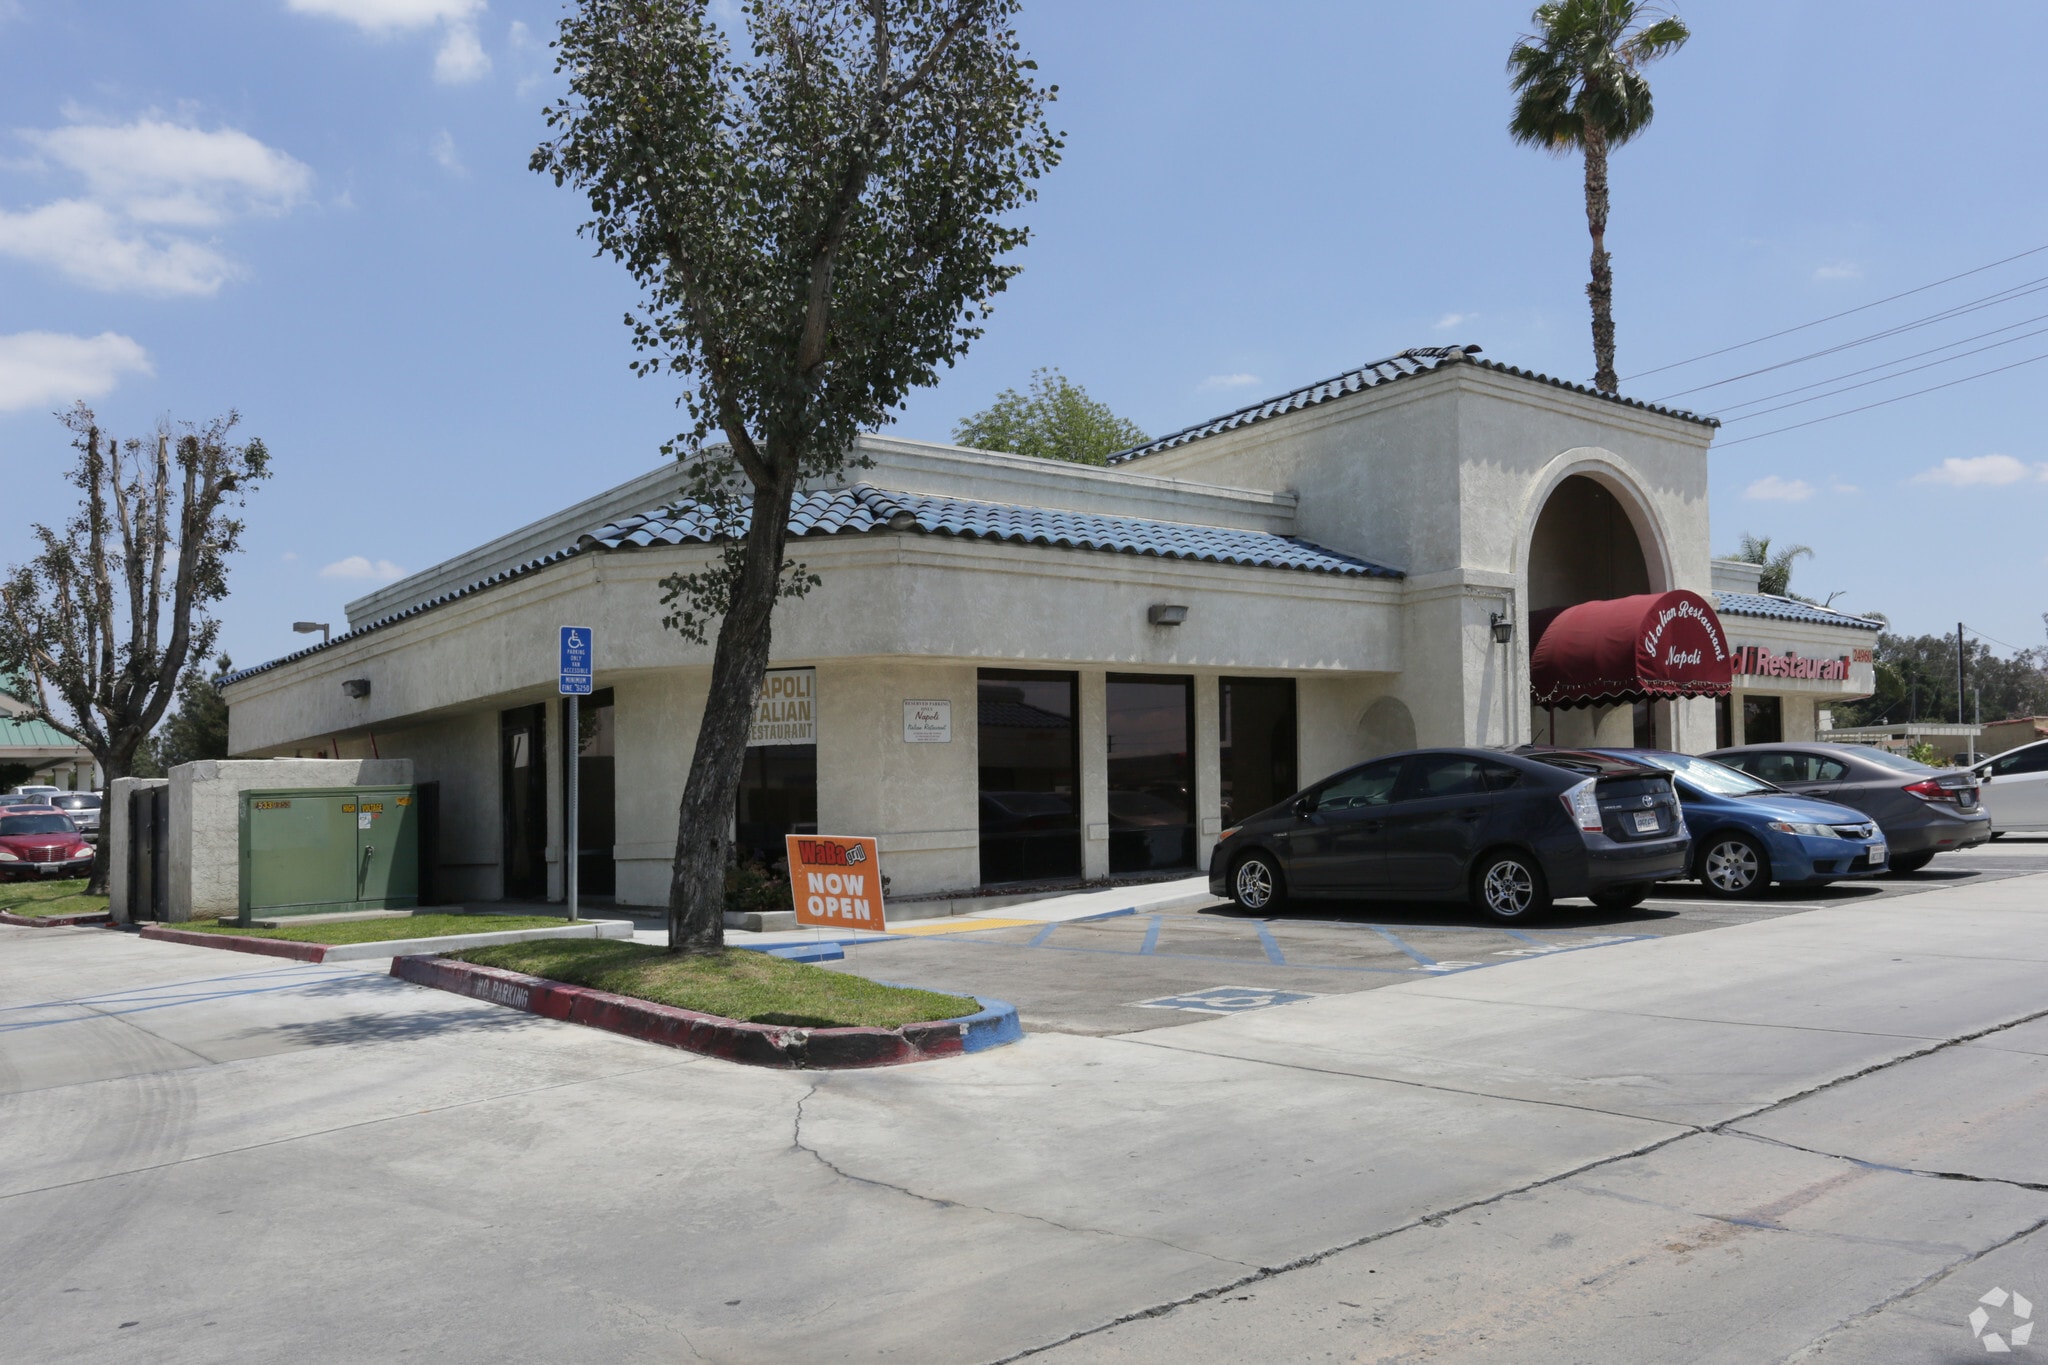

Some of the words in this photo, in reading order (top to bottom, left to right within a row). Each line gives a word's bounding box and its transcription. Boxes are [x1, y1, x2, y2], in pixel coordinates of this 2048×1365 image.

[1645, 607, 1676, 657] Italian
[1678, 600, 1725, 662] Restaurant
[1665, 645, 1702, 669] Napoli
[1756, 646, 1851, 680] Restaurant
[1853, 648, 1872, 663] 24960
[759, 675, 811, 700] APOLI
[752, 700, 811, 723] ALIAN
[914, 711, 939, 723] Napoli
[751, 723, 813, 740] ESTAURANT
[361, 803, 383, 812] VOLTAGE
[798, 840, 847, 866] WaBa
[846, 841, 867, 866] grill
[807, 872, 864, 896] NOW
[807, 895, 871, 920] OPEN
[476, 979, 489, 996] NO
[492, 981, 528, 1007] PARKING
